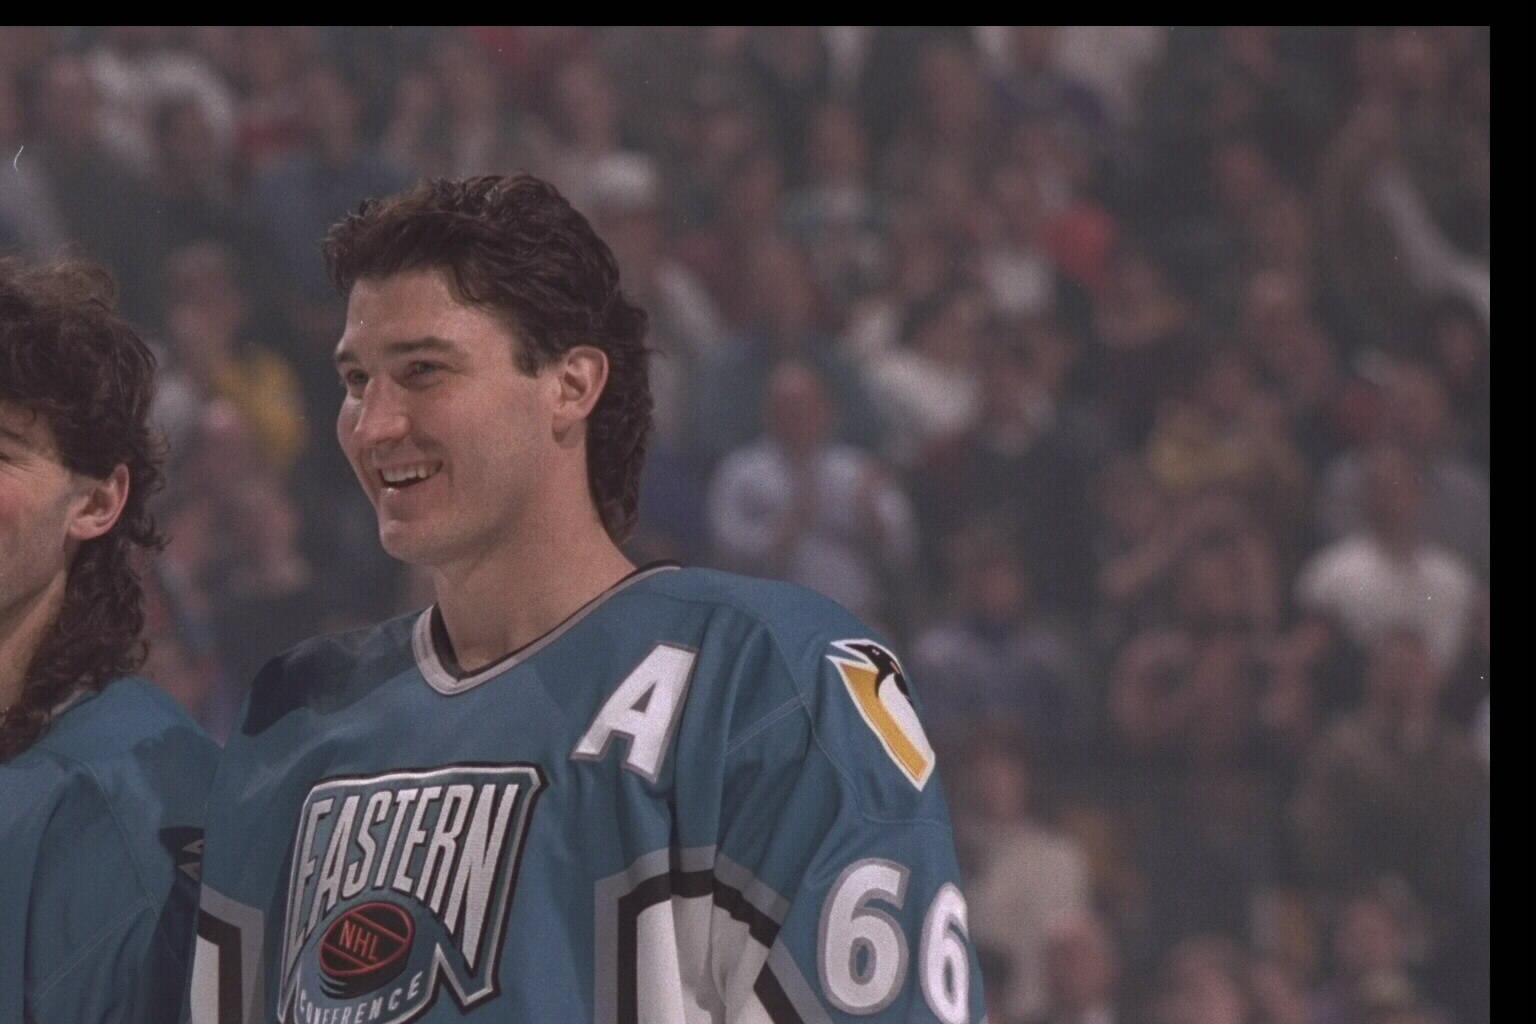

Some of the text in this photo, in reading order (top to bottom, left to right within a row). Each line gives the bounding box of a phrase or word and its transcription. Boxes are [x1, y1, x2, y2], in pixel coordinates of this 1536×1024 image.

[570, 641, 699, 784] A
[284, 784, 519, 988] EASTERN
[339, 920, 379, 961] NHL
